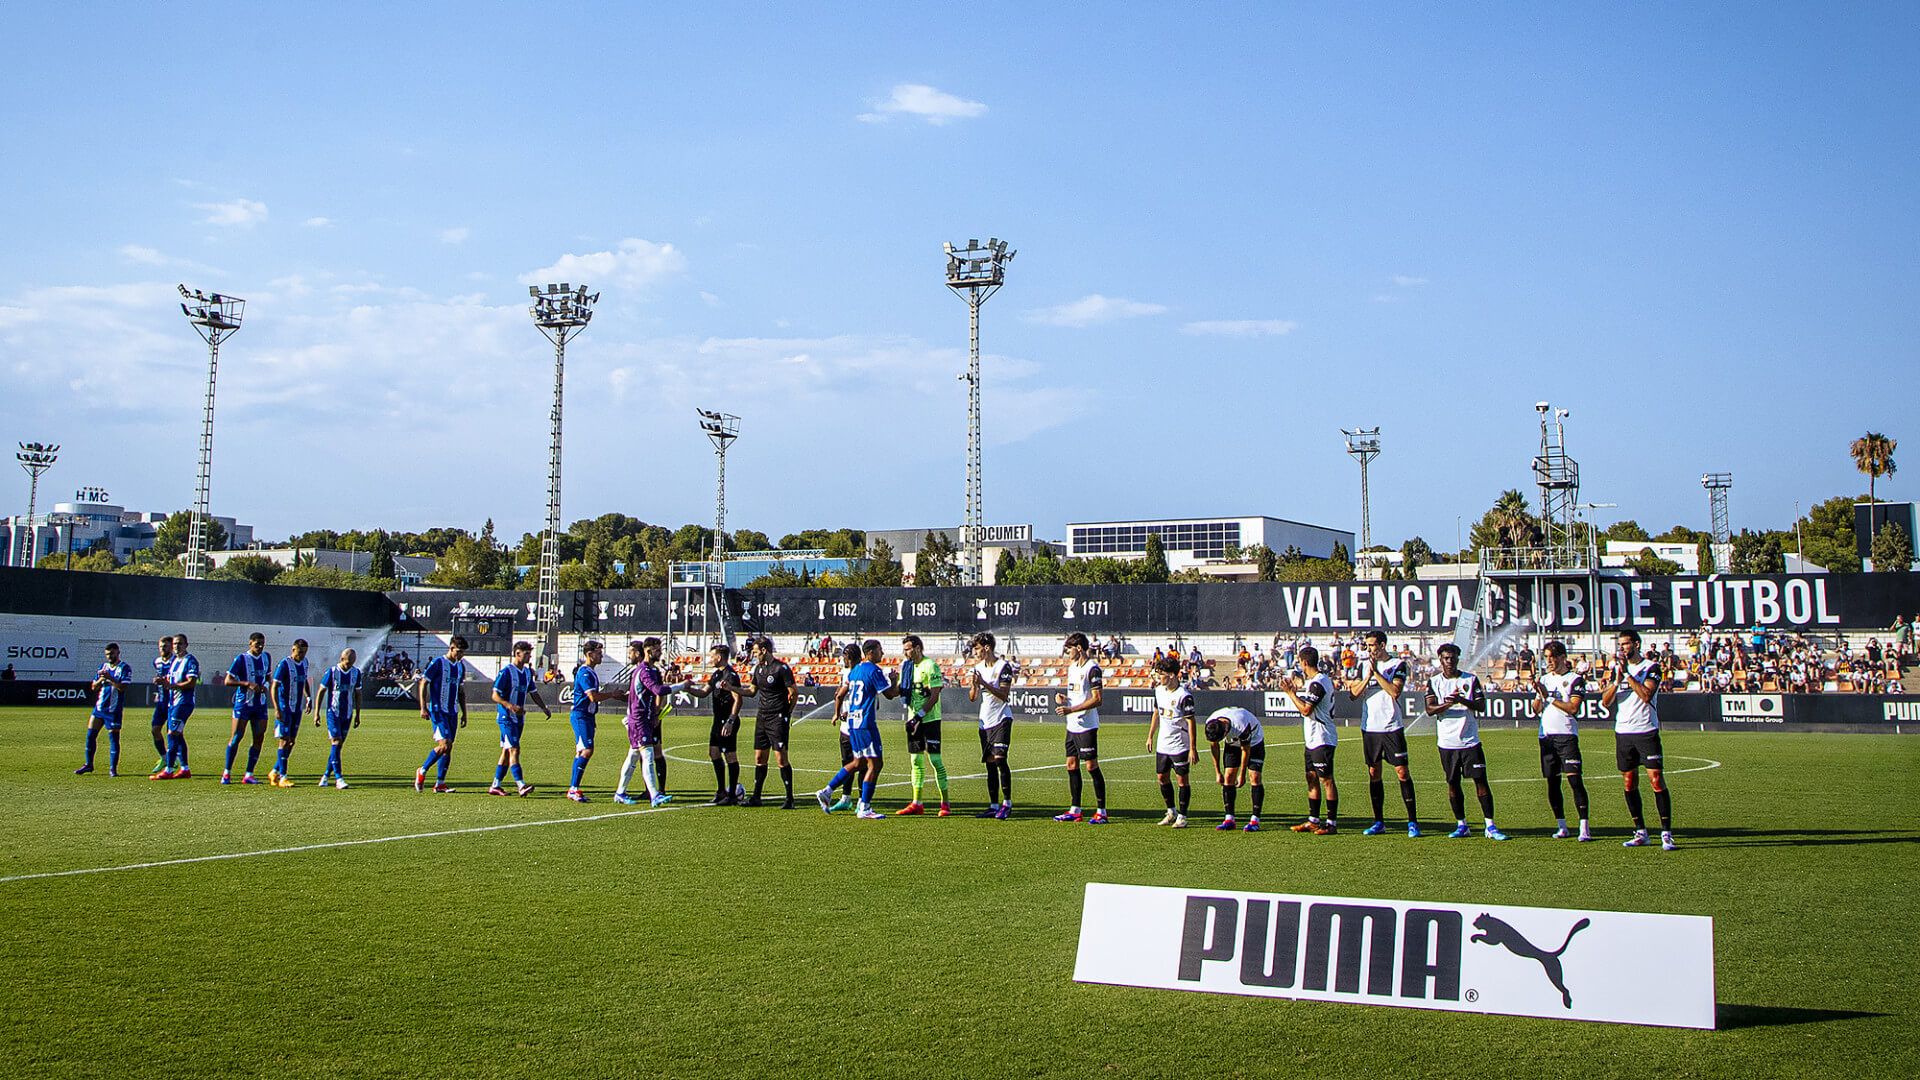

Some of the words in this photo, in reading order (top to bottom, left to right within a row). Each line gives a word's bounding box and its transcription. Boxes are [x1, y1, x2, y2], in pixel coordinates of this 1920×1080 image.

[966, 526, 1026, 541] OCUMET
[1282, 584, 1465, 628] VALENCIA
[1485, 582, 1585, 627] CLUB
[1601, 581, 1656, 626] DE
[1671, 573, 1840, 626] FÚTBOL
[411, 605, 431, 618] 1941
[613, 604, 636, 617] 1947
[756, 603, 781, 617] 1954
[831, 603, 857, 617] 1962
[910, 603, 936, 617] 1963
[993, 601, 1020, 616] 1967
[1081, 601, 1109, 616] 1971
[1007, 691, 1049, 707] divina
[1122, 695, 1156, 712] PUM
[1268, 697, 1286, 707] TM
[1725, 700, 1746, 711] TM
[1024, 707, 1049, 715] seguros
[1177, 895, 1463, 1001] PUMA
